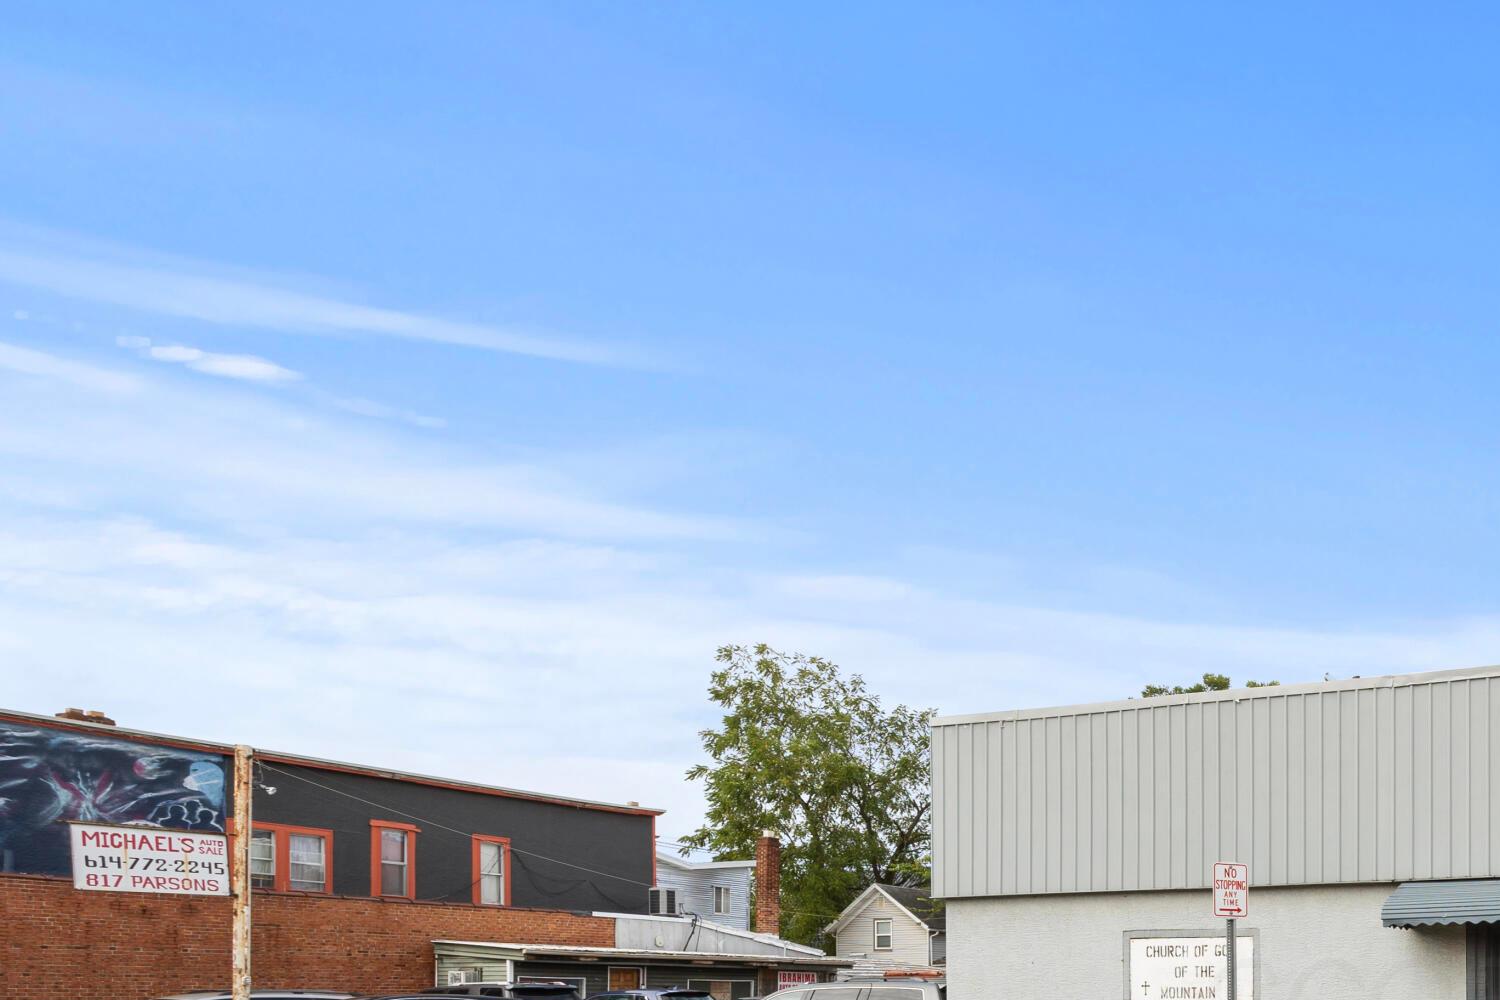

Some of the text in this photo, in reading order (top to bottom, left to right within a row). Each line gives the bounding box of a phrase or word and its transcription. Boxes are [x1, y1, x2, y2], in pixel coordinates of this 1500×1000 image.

[81, 830, 194, 853] MICHAEL'S
[199, 846, 224, 855] SALE
[84, 855, 225, 875] 614-772-2245
[1224, 867, 1237, 878] NO
[86, 874, 219, 892] 817 PARSONS
[1215, 879, 1246, 890] STOPPING
[1224, 890, 1238, 898] ANY
[1223, 898, 1239, 906] TIME
[1146, 944, 1189, 958] CHURCH
[1194, 944, 1209, 958] OF
[779, 972, 816, 983] IBRAHIMA
[1174, 965, 1215, 979] OF THE
[1160, 986, 1216, 999] MOUNTAIN
